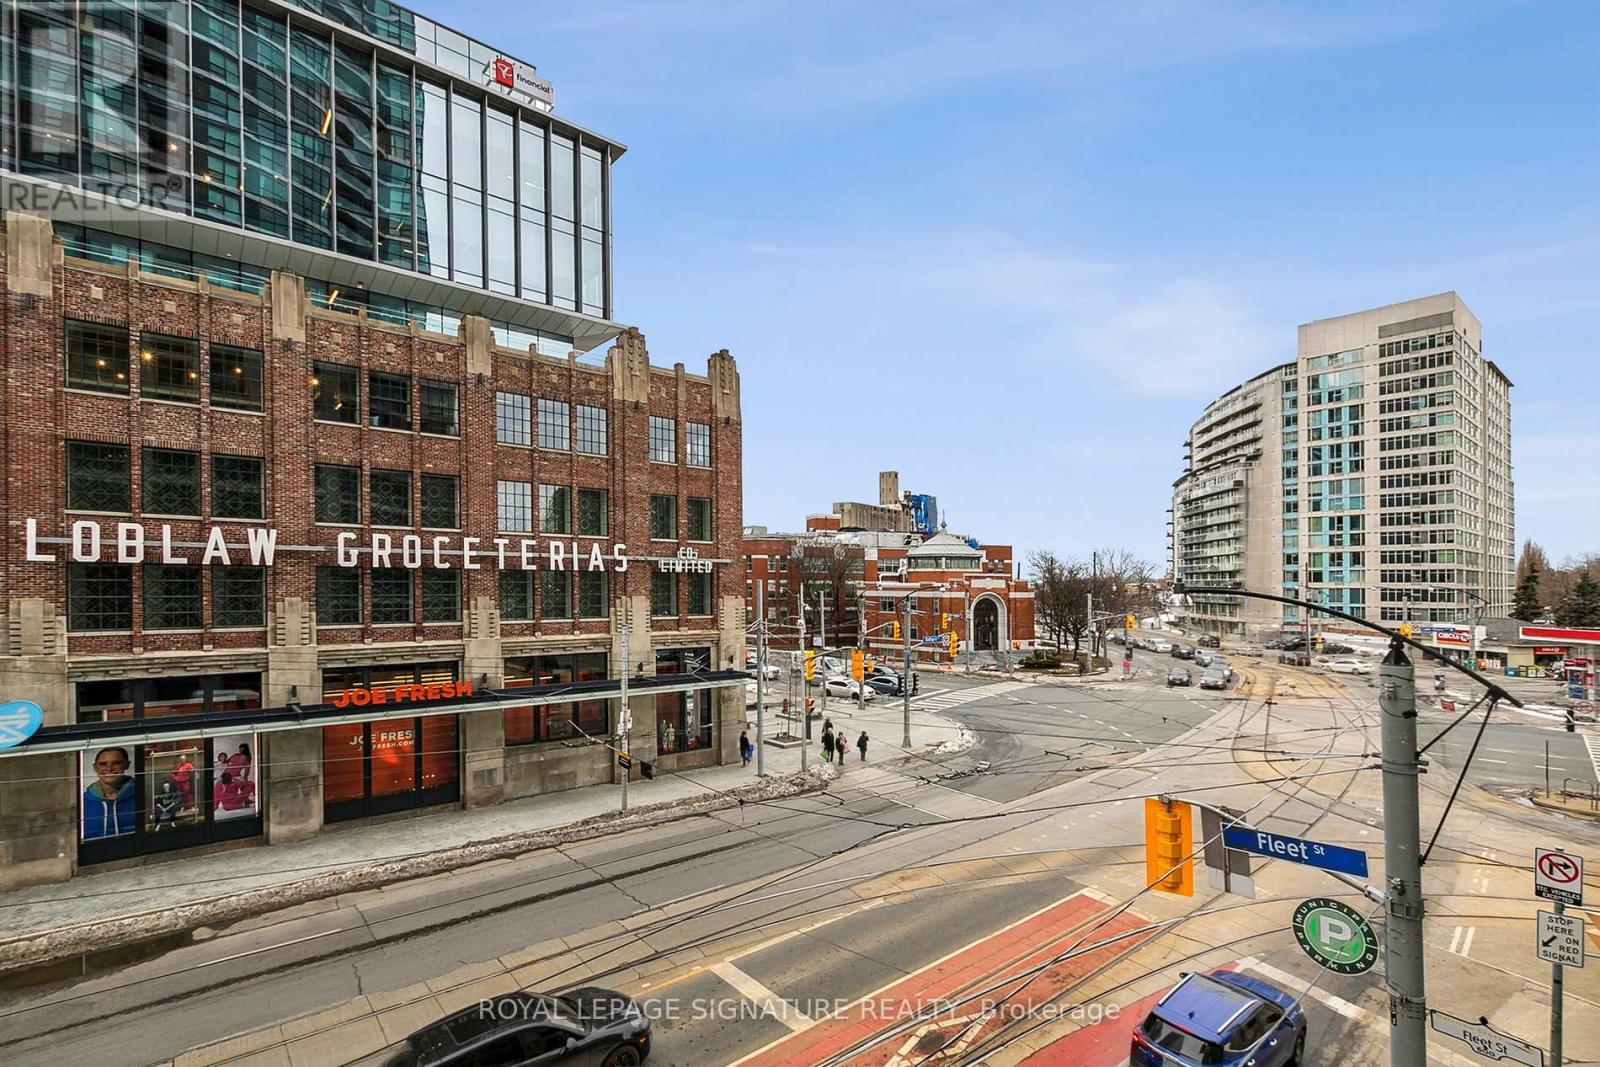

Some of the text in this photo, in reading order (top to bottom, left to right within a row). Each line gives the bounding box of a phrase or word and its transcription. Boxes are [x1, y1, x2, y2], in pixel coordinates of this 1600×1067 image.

[516, 73, 550, 94] financial
[26, 518, 628, 573] LOBLAW GROCETERIAS
[660, 560, 712, 574] LIMITED
[333, 679, 473, 708] JOE FRESH
[381, 730, 415, 743] FRES
[1257, 832, 1325, 860] Fleet St
[1542, 892, 1575, 904] EXCEPTED
[1551, 888, 1581, 900] VEHICLES
[1295, 900, 1374, 943] MUNICIPAL
[1547, 915, 1574, 927] STOP
[1320, 914, 1352, 945] P
[1547, 925, 1574, 936] HERE
[1565, 937, 1580, 946] ON
[1296, 932, 1375, 973] PARKING
[1542, 950, 1578, 964] SIGNAL
[1559, 945, 1579, 955] RED
[1462, 1030, 1508, 1055] Fleet St
